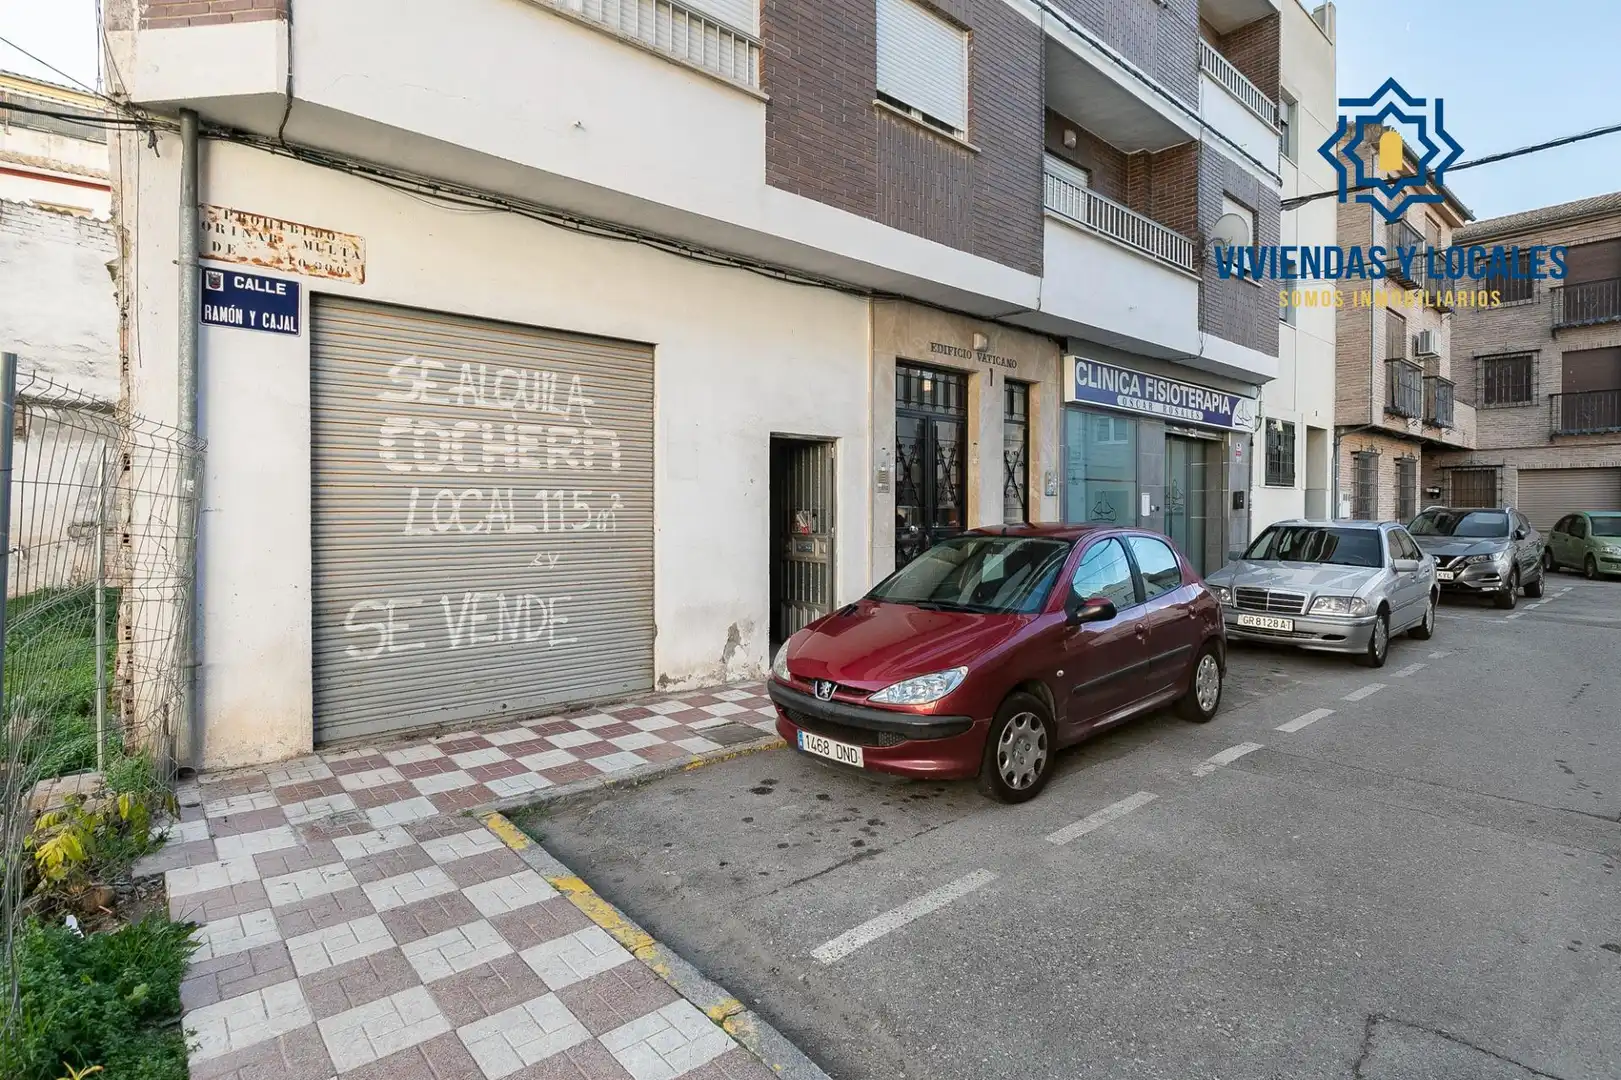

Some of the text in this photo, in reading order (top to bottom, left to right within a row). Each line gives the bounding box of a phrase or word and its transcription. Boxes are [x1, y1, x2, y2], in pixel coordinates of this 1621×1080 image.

[201, 221, 361, 260] ORINAR MULTA
[212, 240, 236, 255] DE
[234, 276, 286, 295] CALLE
[204, 304, 297, 332] RAMÓN Y CAJAL
[930, 342, 1017, 369] EDIFICIO VATICANO
[378, 355, 595, 425] SE ALQUILA
[1075, 361, 1231, 416] CLINICA FISIOTERAPIA
[378, 417, 621, 473] COCHERA
[402, 487, 538, 535] LOCAL
[345, 591, 579, 661] SE VENDE
[806, 735, 858, 764] 1468 DND
